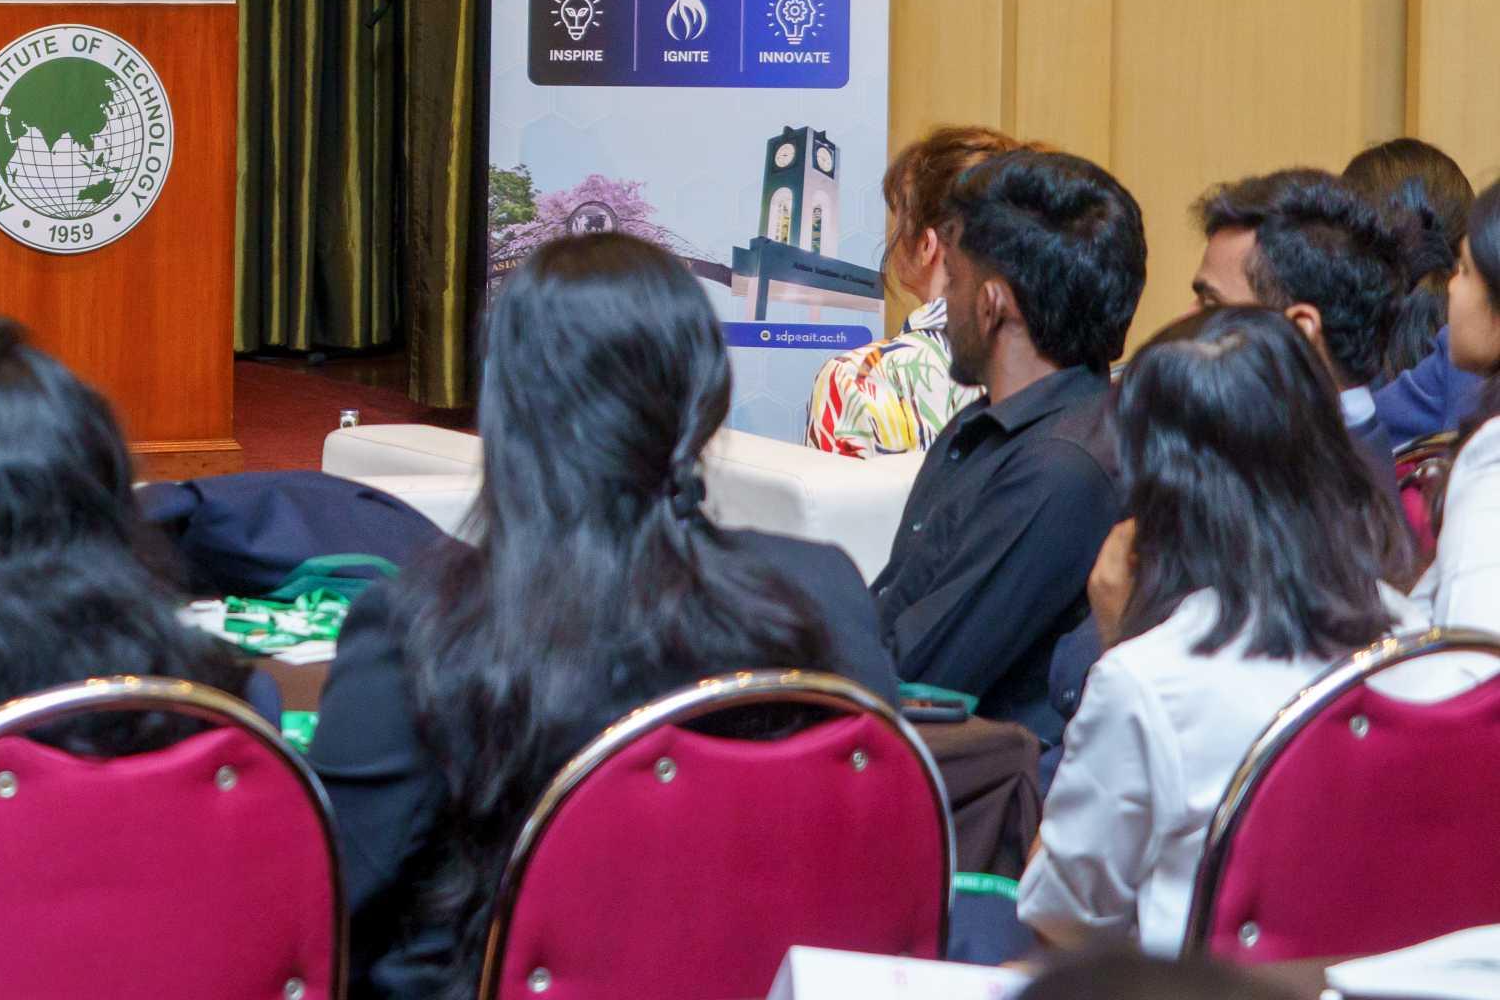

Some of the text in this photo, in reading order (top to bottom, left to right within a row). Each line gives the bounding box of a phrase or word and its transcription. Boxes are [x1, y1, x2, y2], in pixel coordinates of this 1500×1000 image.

[549, 49, 603, 62] INSPIRE
[663, 50, 709, 63] IGNITE
[759, 52, 831, 64] INNOVATE
[72, 34, 102, 54] OF
[111, 48, 165, 208] TECHNOLOGY
[48, 222, 94, 243] 1959
[492, 261, 517, 272] ASIA
[775, 330, 847, 344] sdp@ait.ac.th
